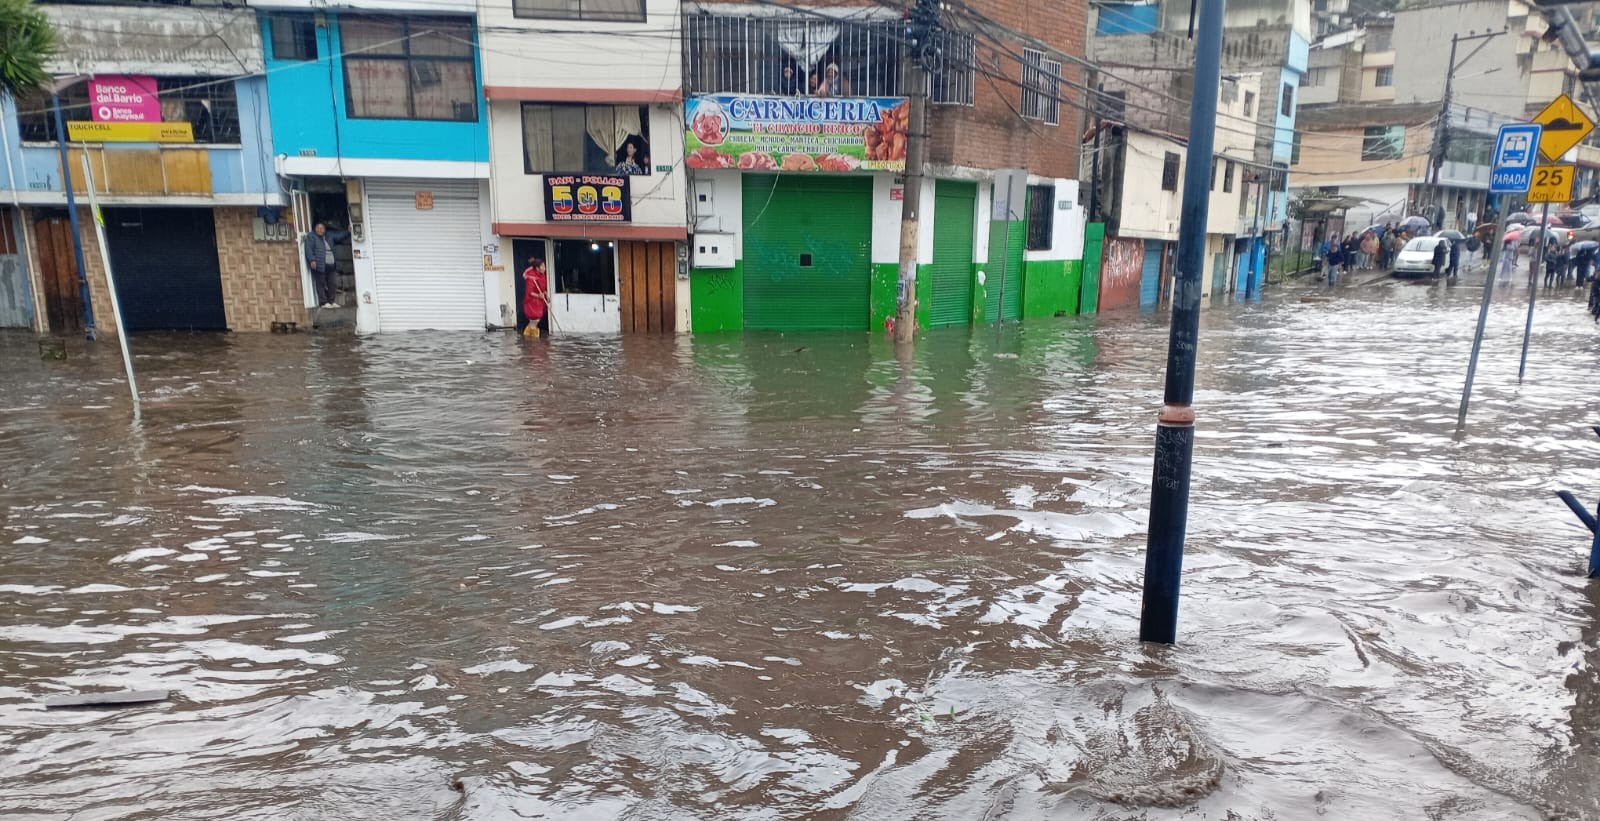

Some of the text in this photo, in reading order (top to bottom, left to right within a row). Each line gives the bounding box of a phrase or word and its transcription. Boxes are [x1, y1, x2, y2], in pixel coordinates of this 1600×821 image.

[95, 84, 127, 94] Banco
[113, 93, 142, 103] Barrio
[729, 99, 883, 121] CARNICERIA
[548, 177, 574, 186] PAPI
[582, 176, 624, 186] POLLOS
[1493, 173, 1527, 185] PARADA
[1537, 170, 1563, 186] 25
[552, 185, 623, 214] 593
